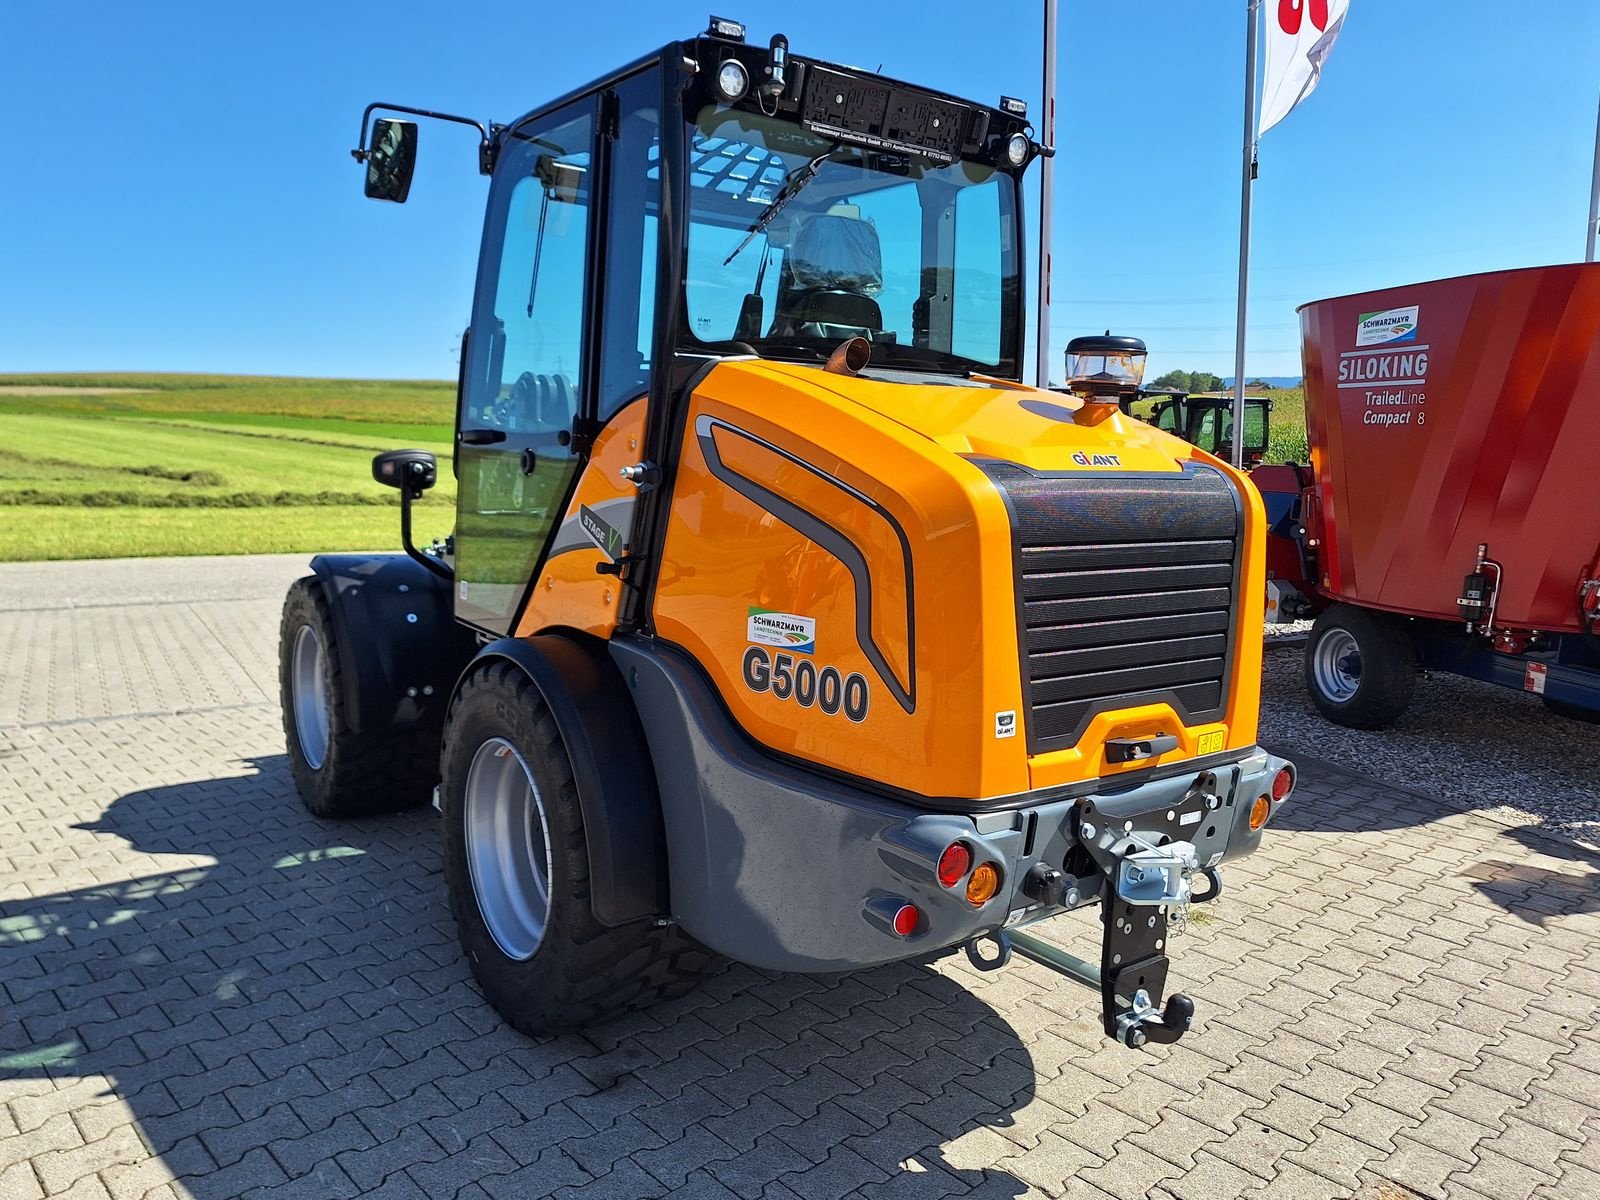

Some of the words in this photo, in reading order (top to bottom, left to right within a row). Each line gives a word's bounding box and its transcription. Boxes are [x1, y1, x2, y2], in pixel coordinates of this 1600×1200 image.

[1363, 315, 1410, 329] SCHWARZMAYR
[1338, 353, 1428, 381] SILOKING
[1365, 390, 1426, 406] TrailedLine
[1363, 410, 1411, 428] Compact
[1417, 411, 1425, 425] 8
[583, 514, 606, 544] STAGE
[608, 526, 622, 553] V
[753, 616, 805, 633] SCHWARZMAYR
[754, 626, 783, 636] LANDTECHNIK
[742, 645, 870, 724] G5000
